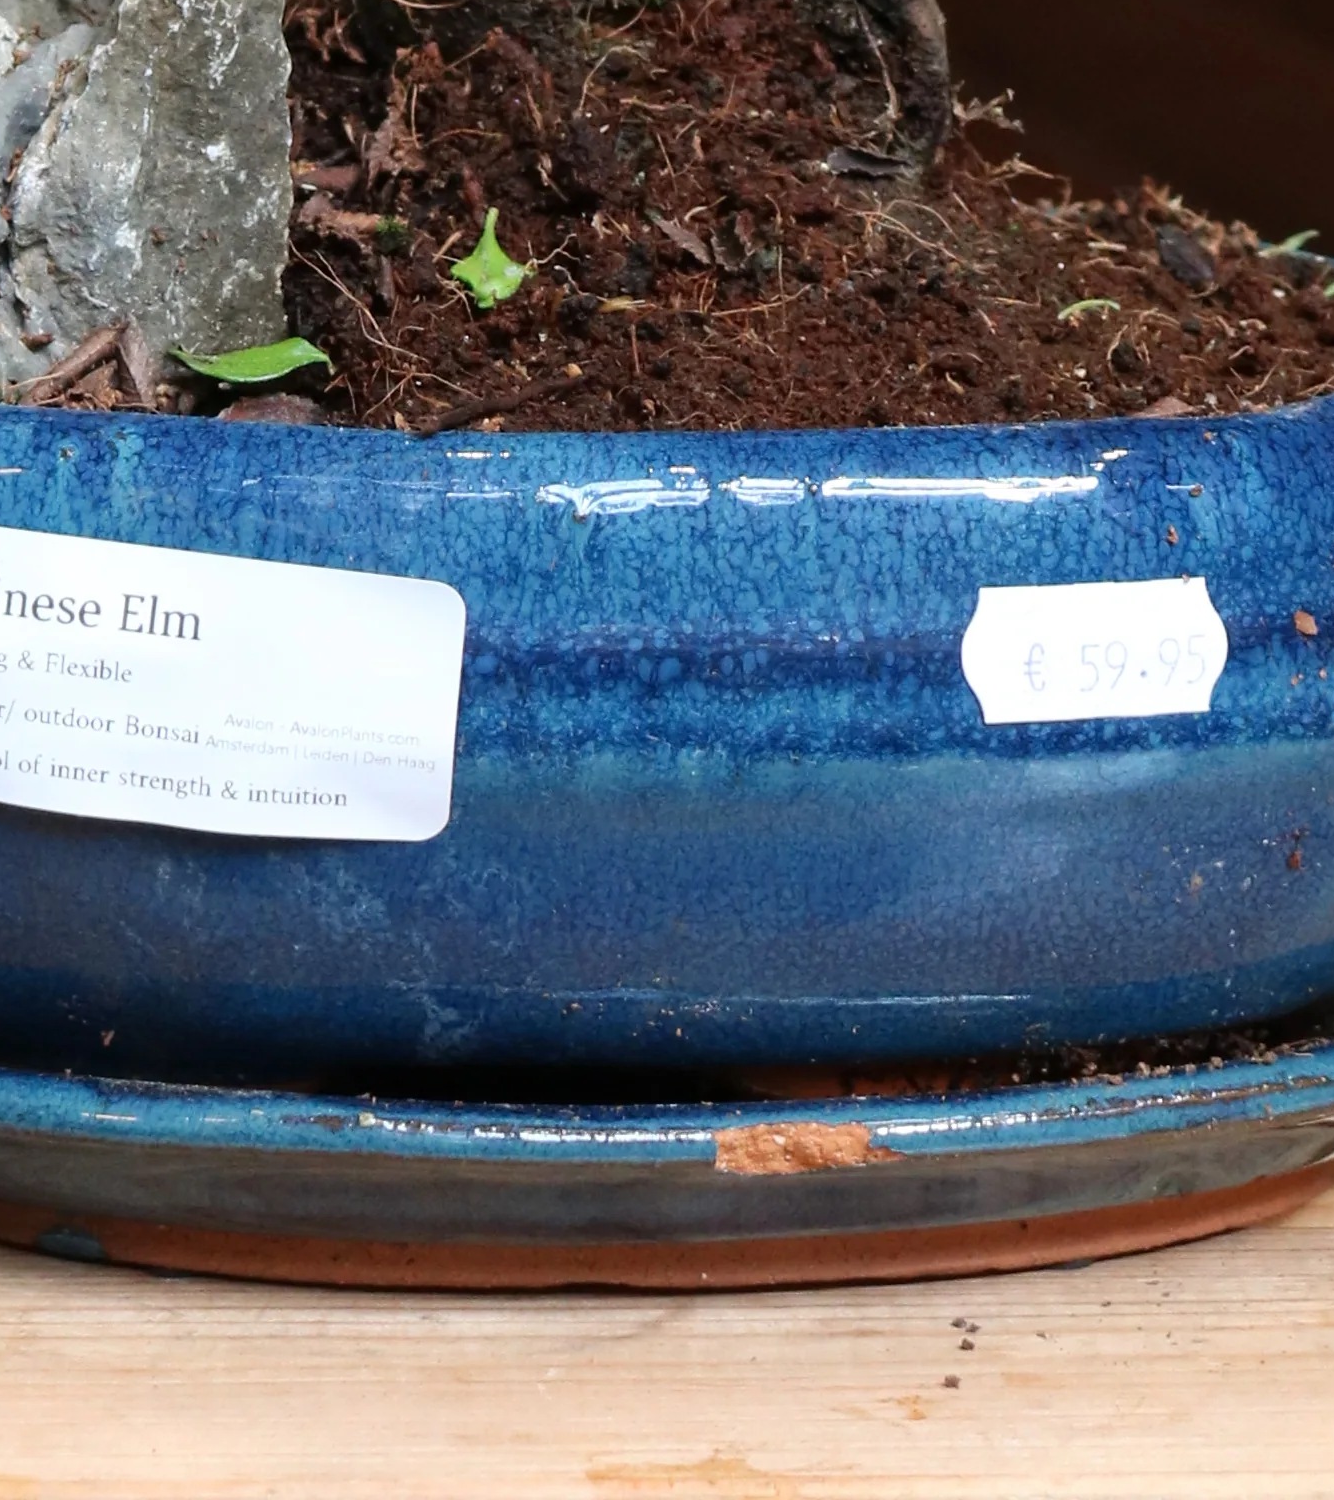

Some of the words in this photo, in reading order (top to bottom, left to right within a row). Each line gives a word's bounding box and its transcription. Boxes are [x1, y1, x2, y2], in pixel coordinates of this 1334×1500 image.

[118, 593, 203, 642] Elm
[17, 650, 36, 671] &
[45, 652, 134, 683] Flexible
[1022, 641, 1047, 692] €
[1079, 634, 1207, 692] 59.95
[23, 707, 117, 733] outdoor
[125, 714, 200, 745] Bonsai
[223, 713, 275, 731] Avalon
[289, 720, 421, 747] AvalonPlantscom
[205, 734, 290, 757] Amsterdam
[302, 746, 350, 764] Leiden
[362, 751, 392, 766] Den
[397, 757, 437, 773] Haag
[17, 754, 43, 775] of
[49, 758, 111, 784] inner
[118, 771, 213, 800] strength
[220, 778, 239, 801] &
[247, 783, 349, 808] intuition
